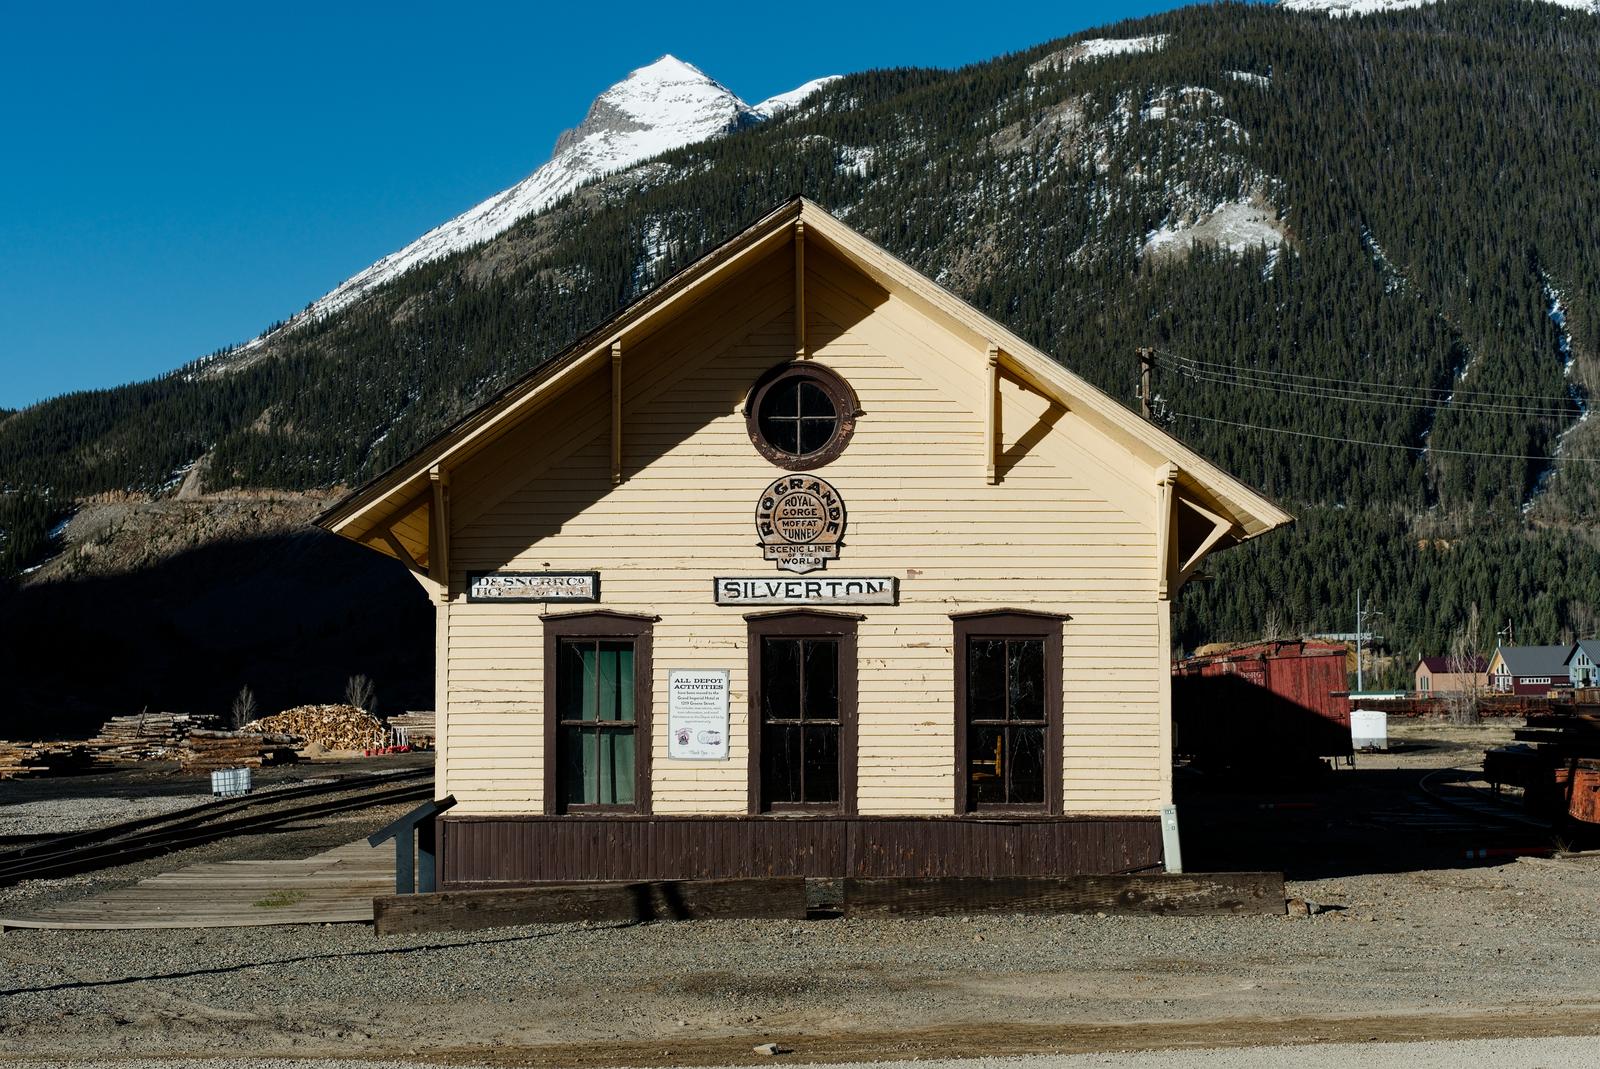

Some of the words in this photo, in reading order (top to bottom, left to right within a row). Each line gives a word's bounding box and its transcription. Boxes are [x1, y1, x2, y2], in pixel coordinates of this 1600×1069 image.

[785, 496, 815, 507] ROYAL
[760, 497, 774, 537] RIO
[774, 479, 840, 535] GRANDE
[782, 508, 818, 516] GORGE
[783, 529, 818, 540] TUNNEL
[724, 581, 884, 598] SILVERTON
